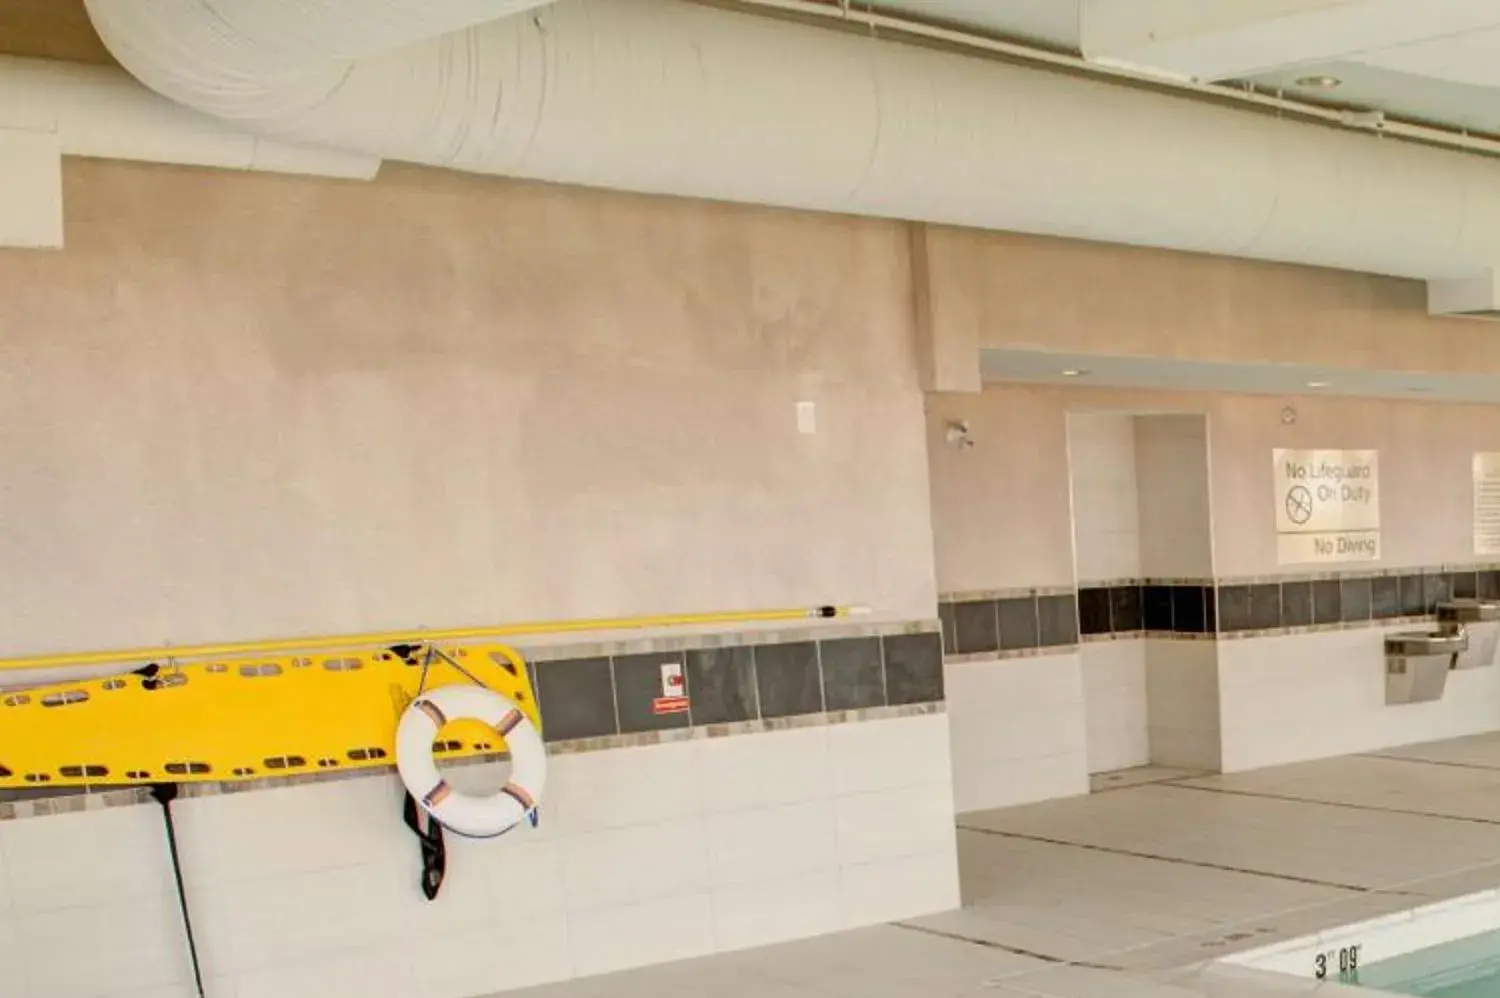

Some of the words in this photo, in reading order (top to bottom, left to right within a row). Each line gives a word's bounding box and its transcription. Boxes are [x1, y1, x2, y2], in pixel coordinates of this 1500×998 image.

[1285, 462, 1305, 480] No
[1311, 462, 1370, 483] Lifeguard
[1317, 485, 1337, 502] On
[1341, 484, 1370, 505] Duty
[1314, 538, 1333, 556] No
[1337, 537, 1375, 556] Diving
[1316, 954, 1326, 979] 3
